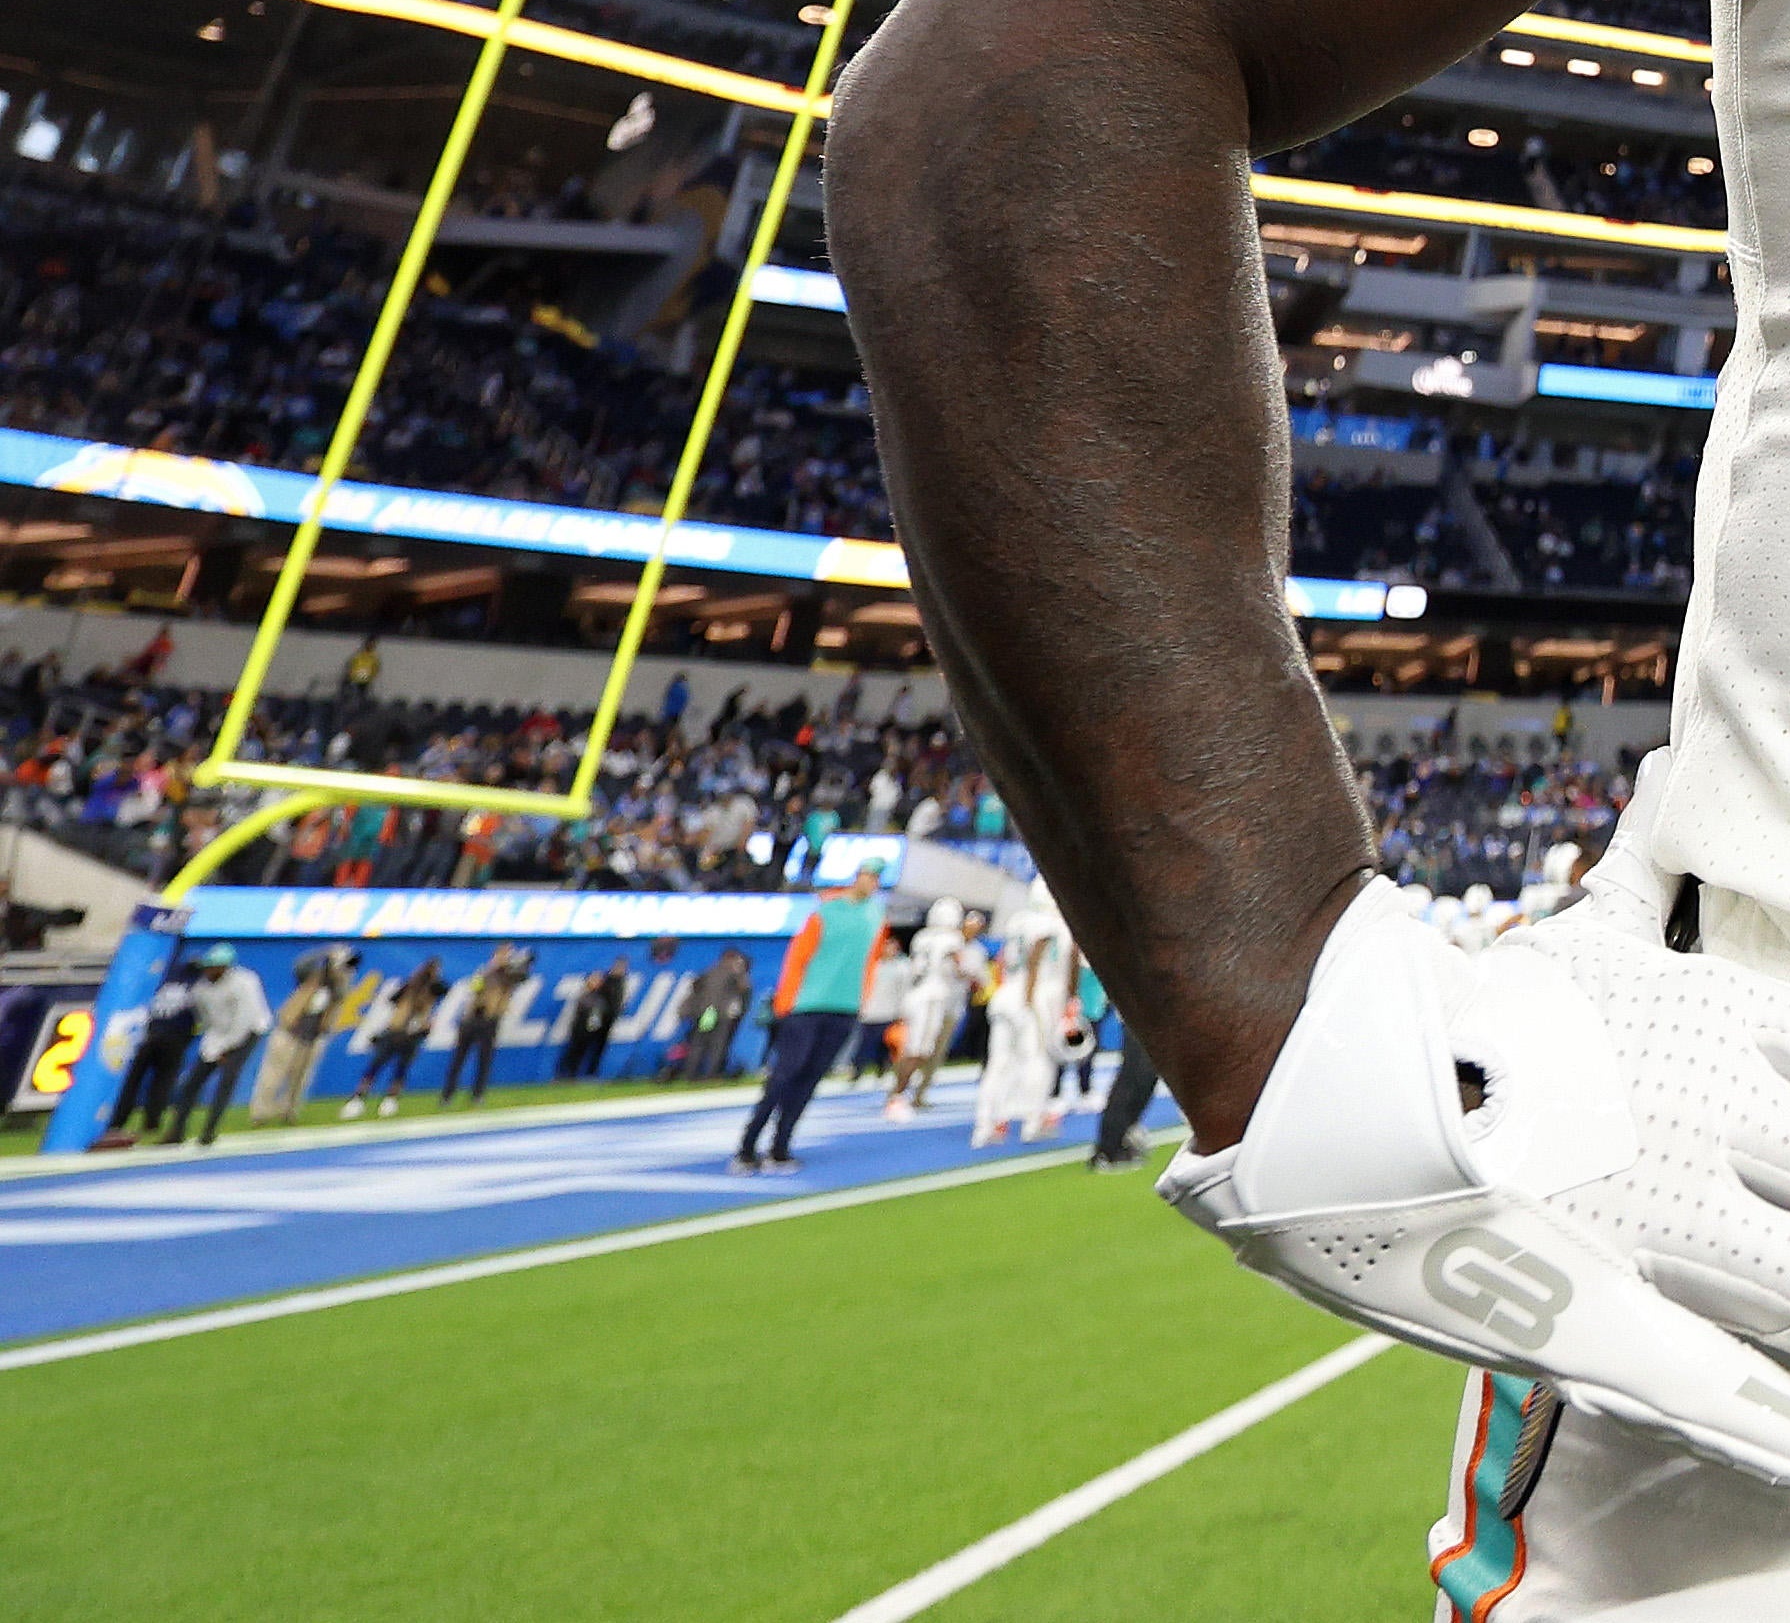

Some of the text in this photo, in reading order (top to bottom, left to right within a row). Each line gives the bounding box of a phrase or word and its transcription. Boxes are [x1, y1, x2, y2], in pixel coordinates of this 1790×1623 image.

[265, 892, 793, 938] LOS ANGELES CHARGERS
[33, 1009, 95, 1094] 2
